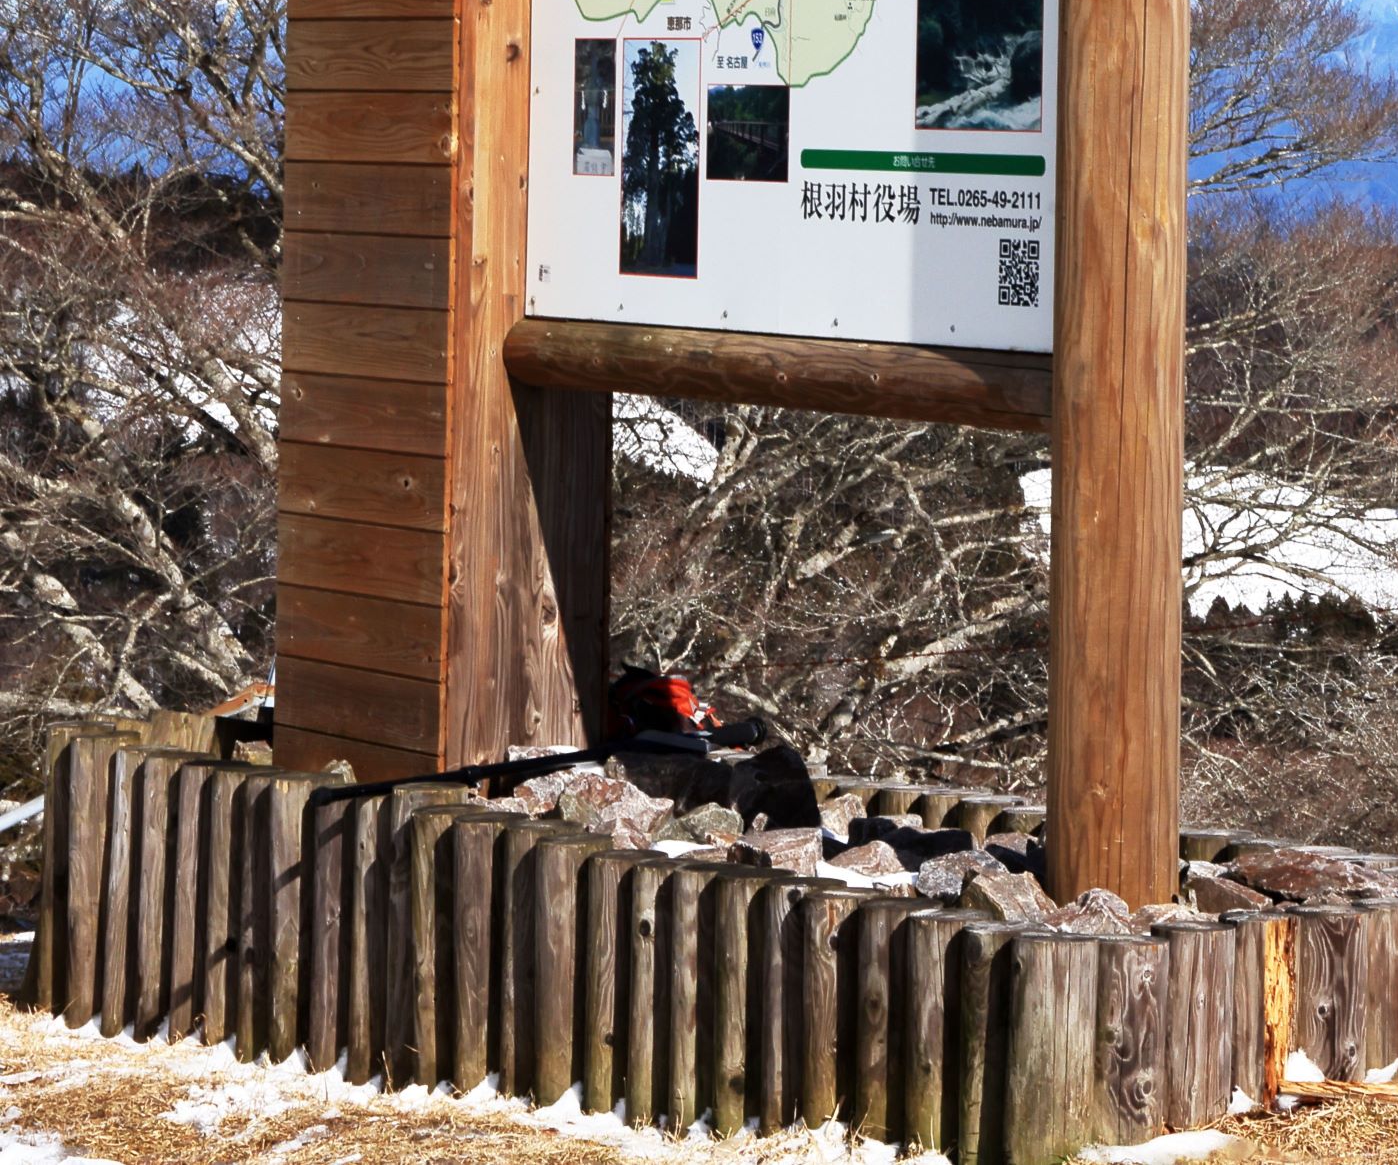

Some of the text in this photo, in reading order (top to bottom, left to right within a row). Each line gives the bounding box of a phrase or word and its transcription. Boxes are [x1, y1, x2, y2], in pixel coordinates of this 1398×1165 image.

[667, 17, 692, 31] 恵那市
[717, 56, 748, 69] 至 名古屋
[801, 180, 921, 225] 根羽村役場
[929, 188, 1041, 210] TEL.0265-49-2111
[930, 212, 1042, 232] http://www.nebamura.jp/
